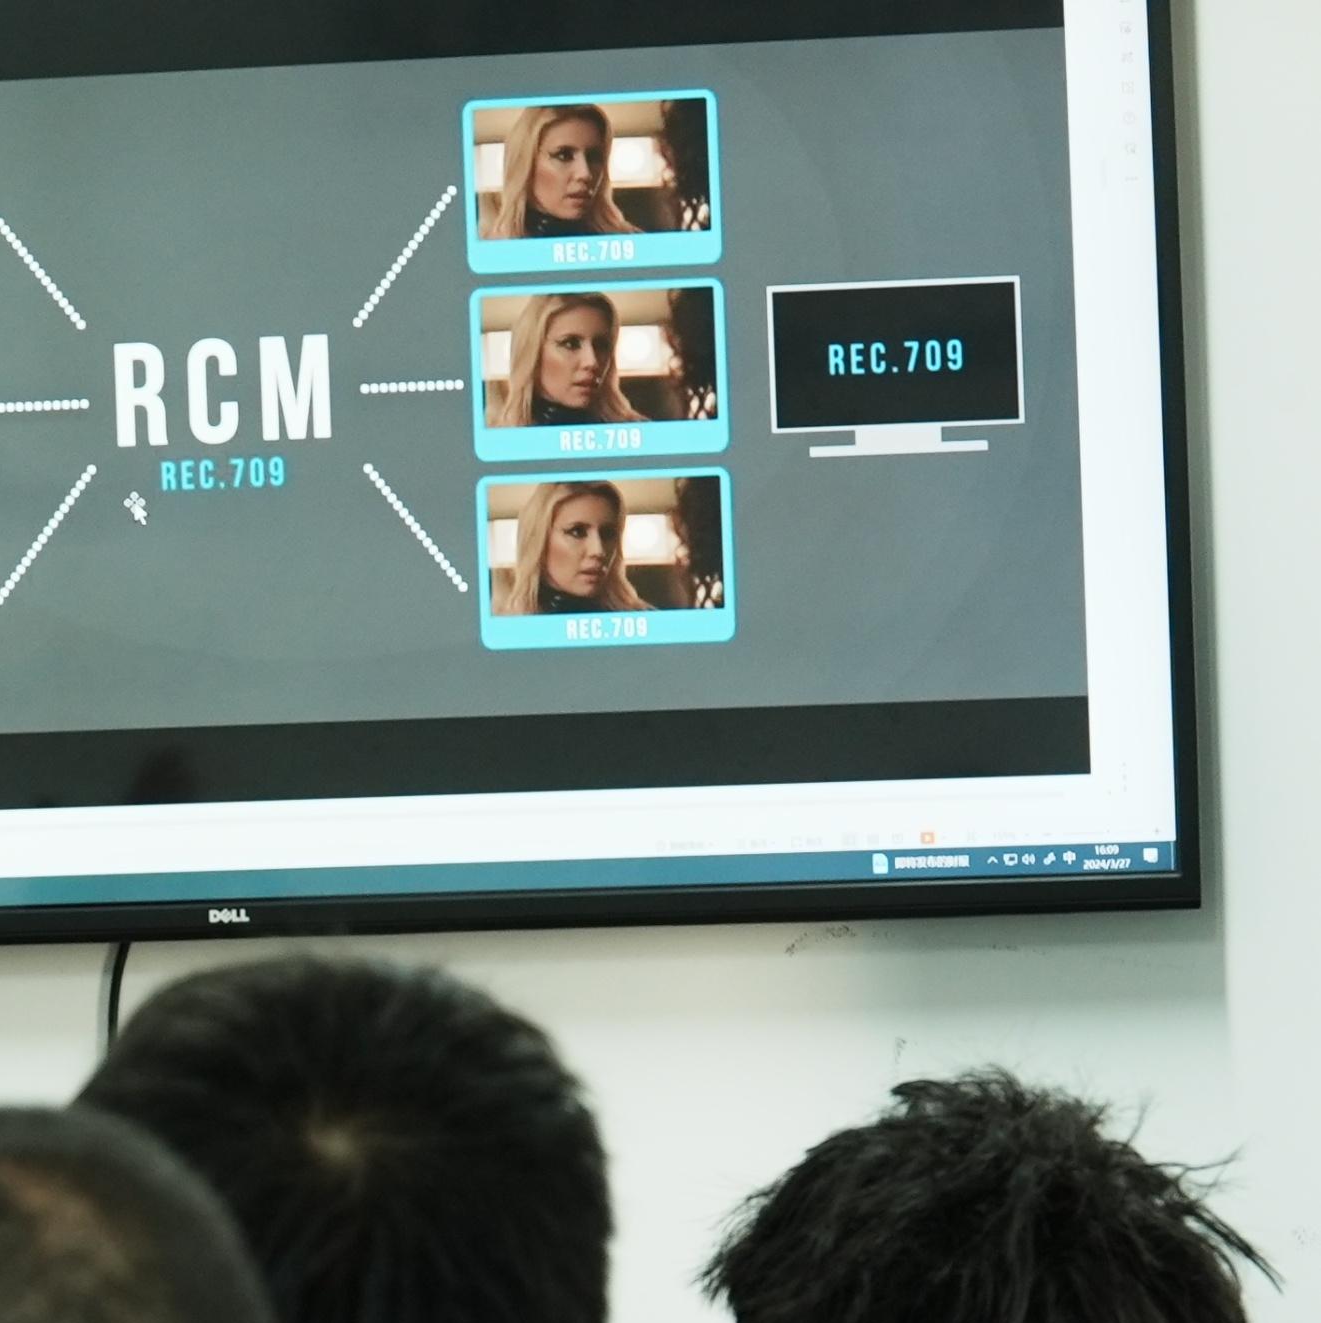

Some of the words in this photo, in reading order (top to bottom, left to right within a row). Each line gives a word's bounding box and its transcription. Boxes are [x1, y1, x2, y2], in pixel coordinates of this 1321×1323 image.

[552, 239, 635, 264] REC.709
[827, 338, 965, 376] REC.709
[113, 333, 333, 448] RCM
[559, 427, 642, 452] REC.709
[160, 456, 286, 491] REC.709
[566, 616, 648, 641] REC.709
[208, 907, 251, 924] DELL
